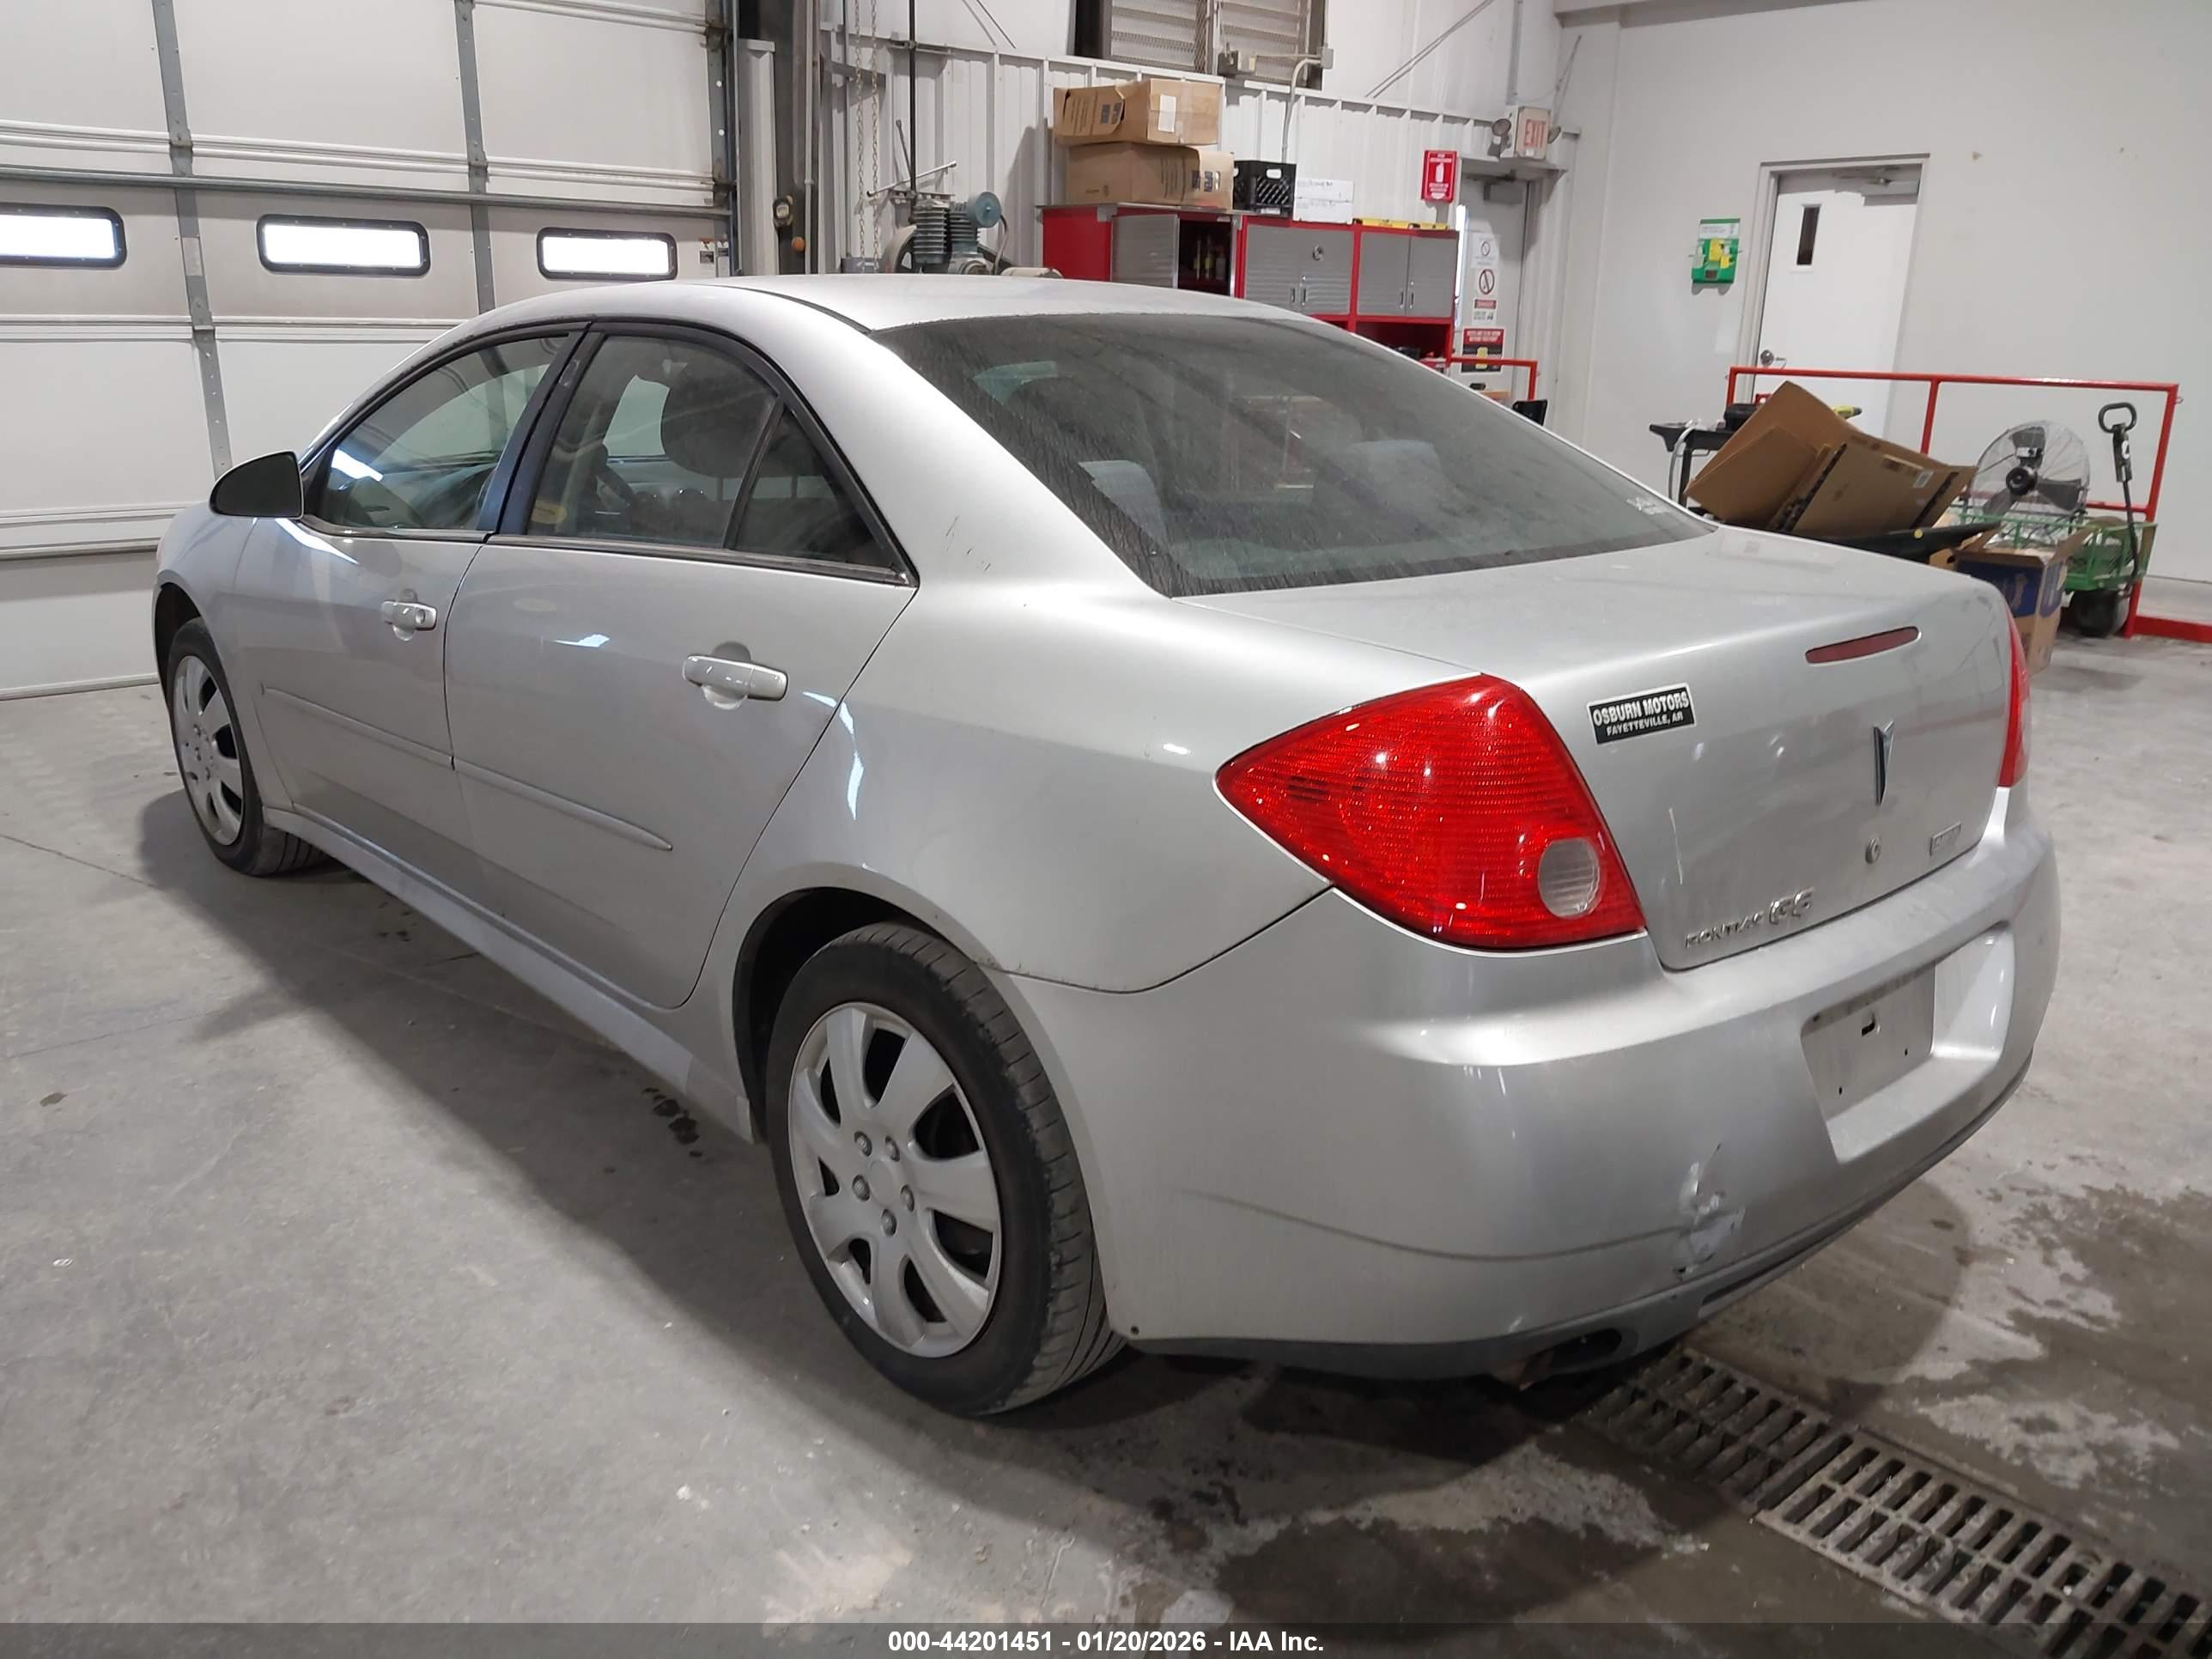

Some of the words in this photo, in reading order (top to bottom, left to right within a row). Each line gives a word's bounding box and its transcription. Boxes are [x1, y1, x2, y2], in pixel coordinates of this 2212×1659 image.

[1523, 119, 1547, 148] EXIT
[1593, 701, 1642, 726] OSBURN
[1643, 691, 1690, 716] MOTORS
[1607, 714, 1671, 737] FAYETTEVILLE,
[1672, 711, 1684, 722] AR
[1684, 911, 1764, 948] PONTIAC
[1769, 886, 1815, 925] G6
